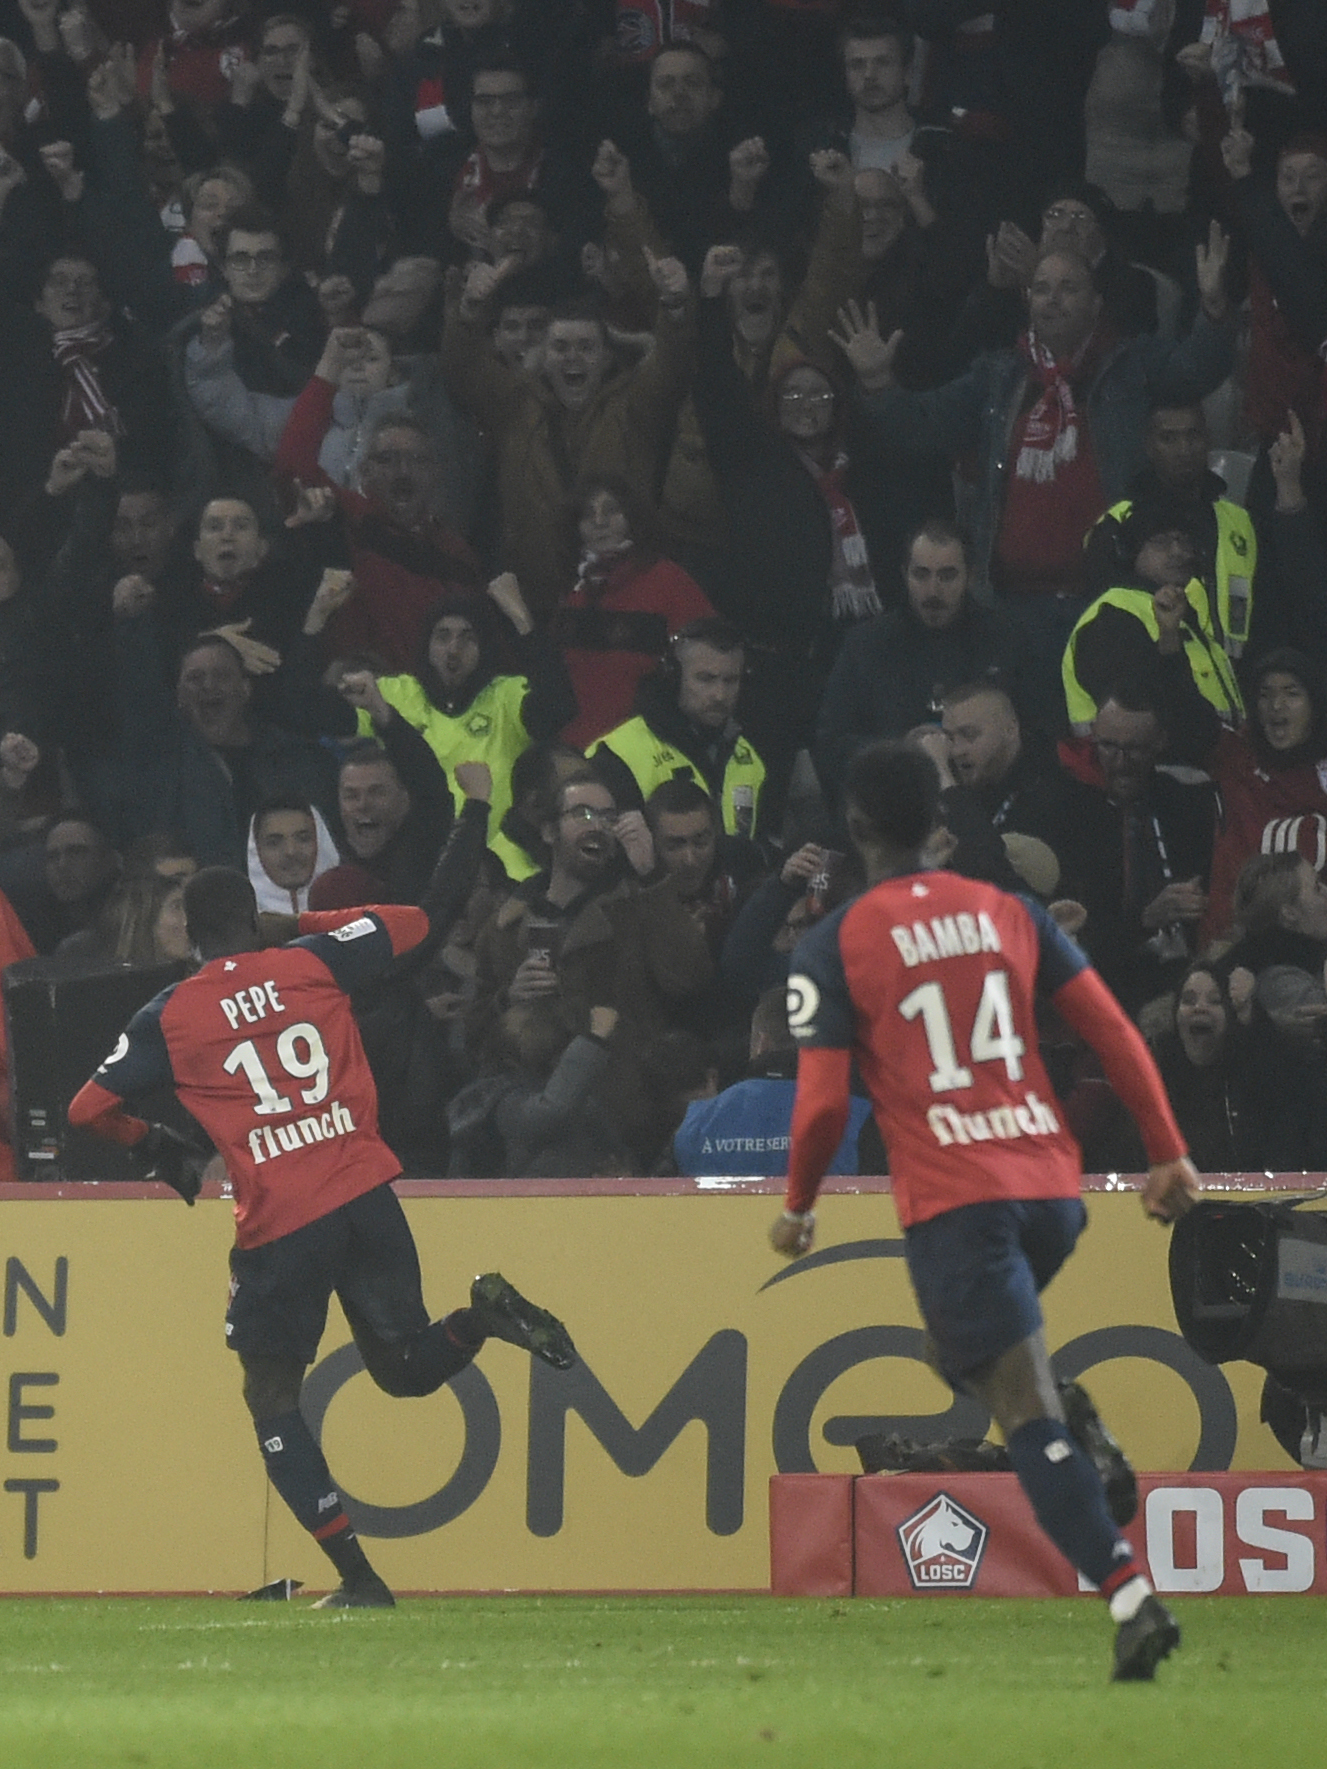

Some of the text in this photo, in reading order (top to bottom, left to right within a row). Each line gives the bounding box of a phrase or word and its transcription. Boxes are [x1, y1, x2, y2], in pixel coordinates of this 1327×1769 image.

[890, 910, 1002, 968] BAMBA
[219, 980, 286, 1030] PEPE
[898, 970, 1026, 1094] 14
[222, 1022, 330, 1116] 19
[248, 1101, 357, 1166] flunch
[716, 1138, 765, 1152] VOTRE
[920, 1564, 965, 1580] LOSC
